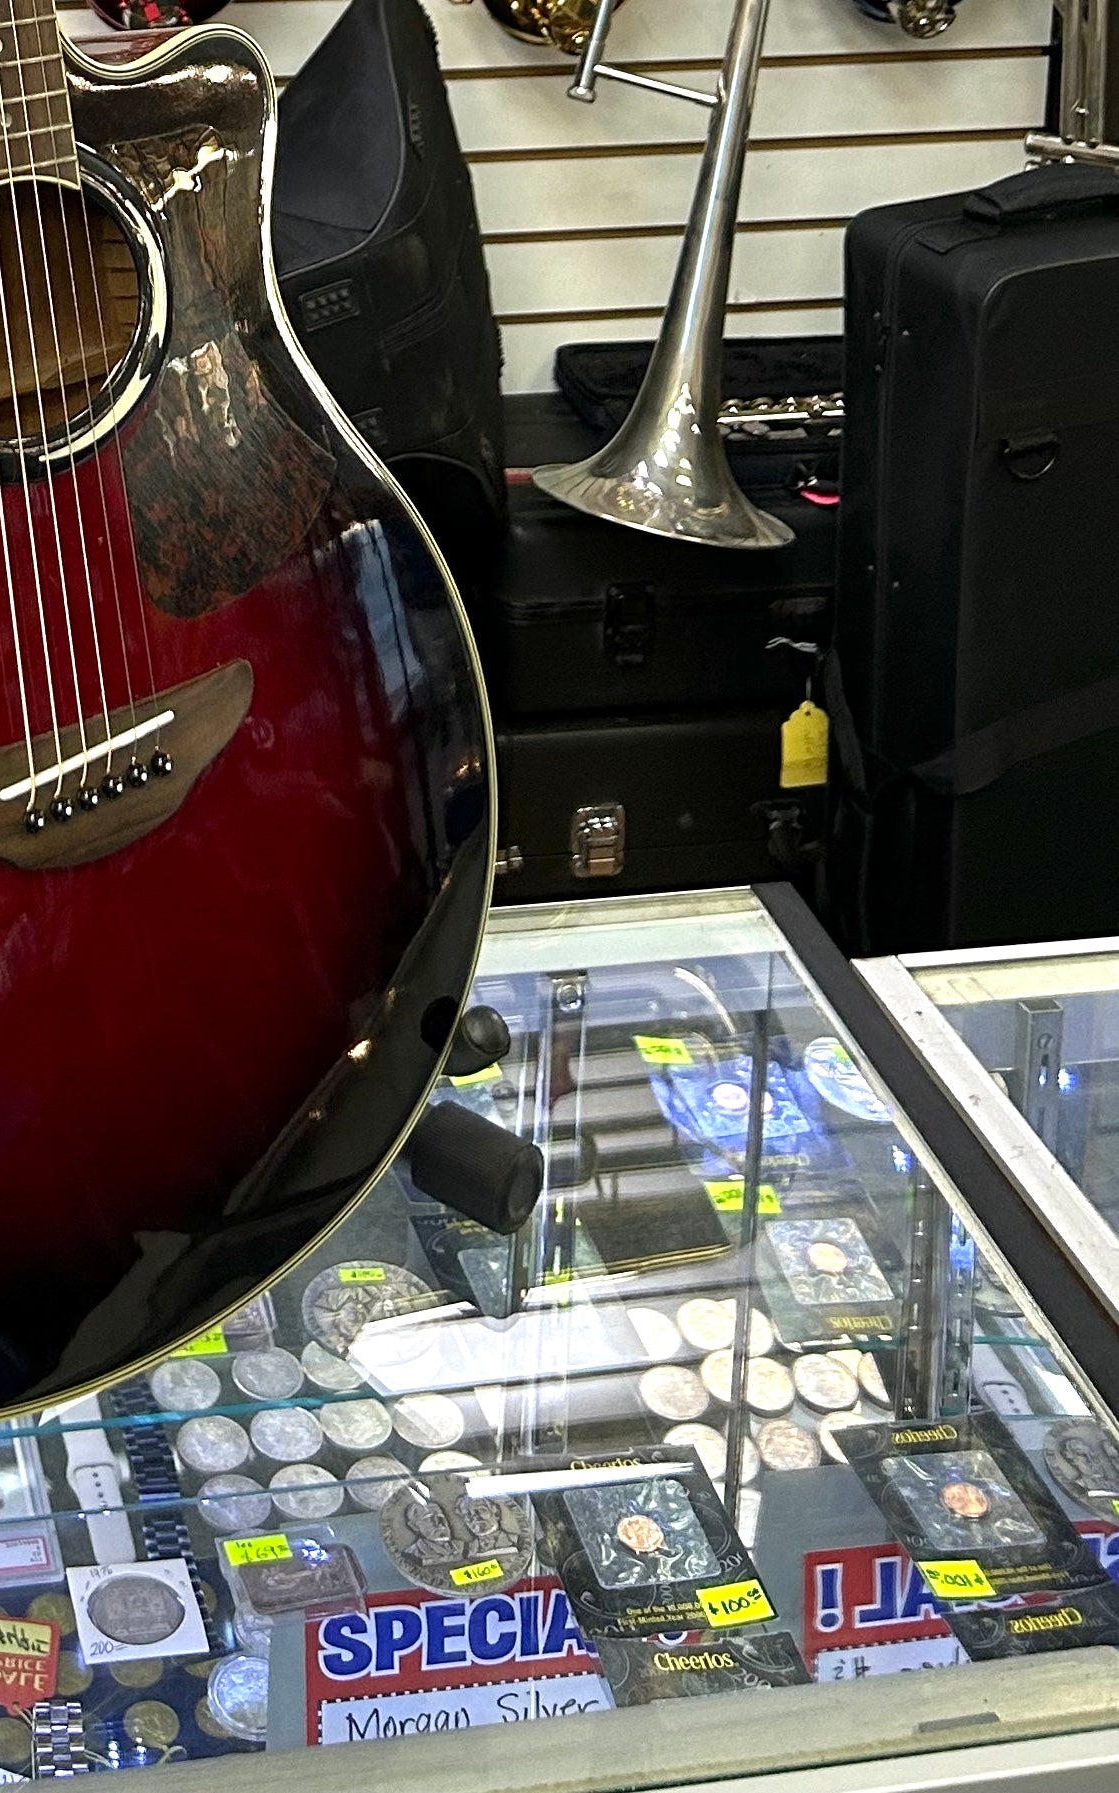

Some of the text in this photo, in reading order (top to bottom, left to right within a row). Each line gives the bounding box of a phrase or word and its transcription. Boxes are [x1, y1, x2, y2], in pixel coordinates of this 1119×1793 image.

[319, 1589, 599, 1680] SPECIA
[654, 1652, 735, 1672] Cheerios
[346, 1690, 600, 1742] Morgan Silver
